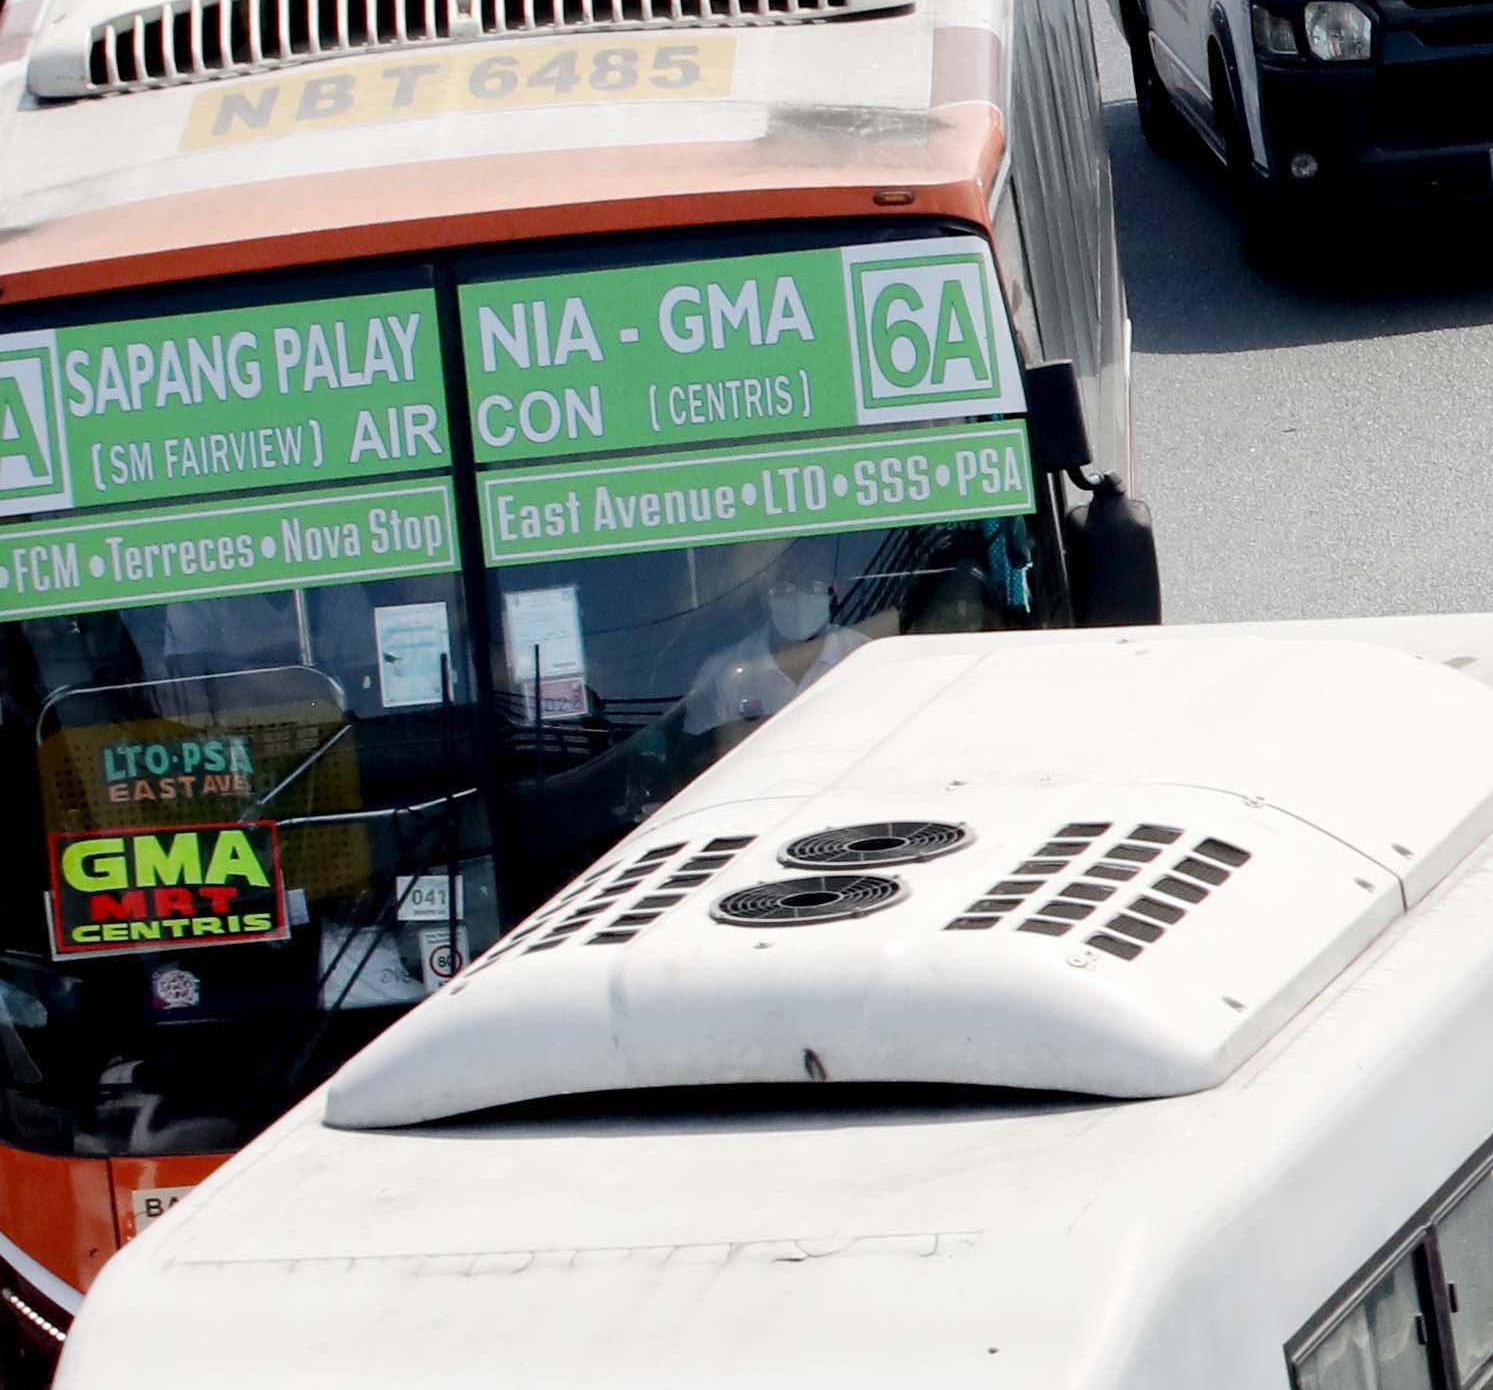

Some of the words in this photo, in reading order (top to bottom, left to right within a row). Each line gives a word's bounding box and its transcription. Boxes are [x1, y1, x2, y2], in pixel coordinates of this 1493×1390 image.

[468, 44, 701, 100] 6485
[478, 297, 604, 373] NIA
[658, 275, 817, 355] GMA
[870, 278, 991, 389] 6A
[65, 331, 264, 419] SAPANG
[272, 313, 421, 395] PALAY
[350, 403, 444, 464] AIR
[477, 386, 604, 448] CON
[499, 491, 582, 542] East
[594, 479, 737, 533] Avenue
[761, 464, 828, 517] LTO
[853, 454, 931, 506] SSS
[955, 444, 1023, 498] PSA
[13, 542, 82, 595] FCM
[105, 534, 255, 584] Terreces
[280, 516, 363, 564] Nova
[367, 506, 443, 557] Stop
[107, 775, 196, 803] EAST
[61, 829, 272, 893] GMA
[71, 913, 273, 943] CENTRIS
[89, 886, 240, 922] MRT
[411, 888, 447, 906] 041
